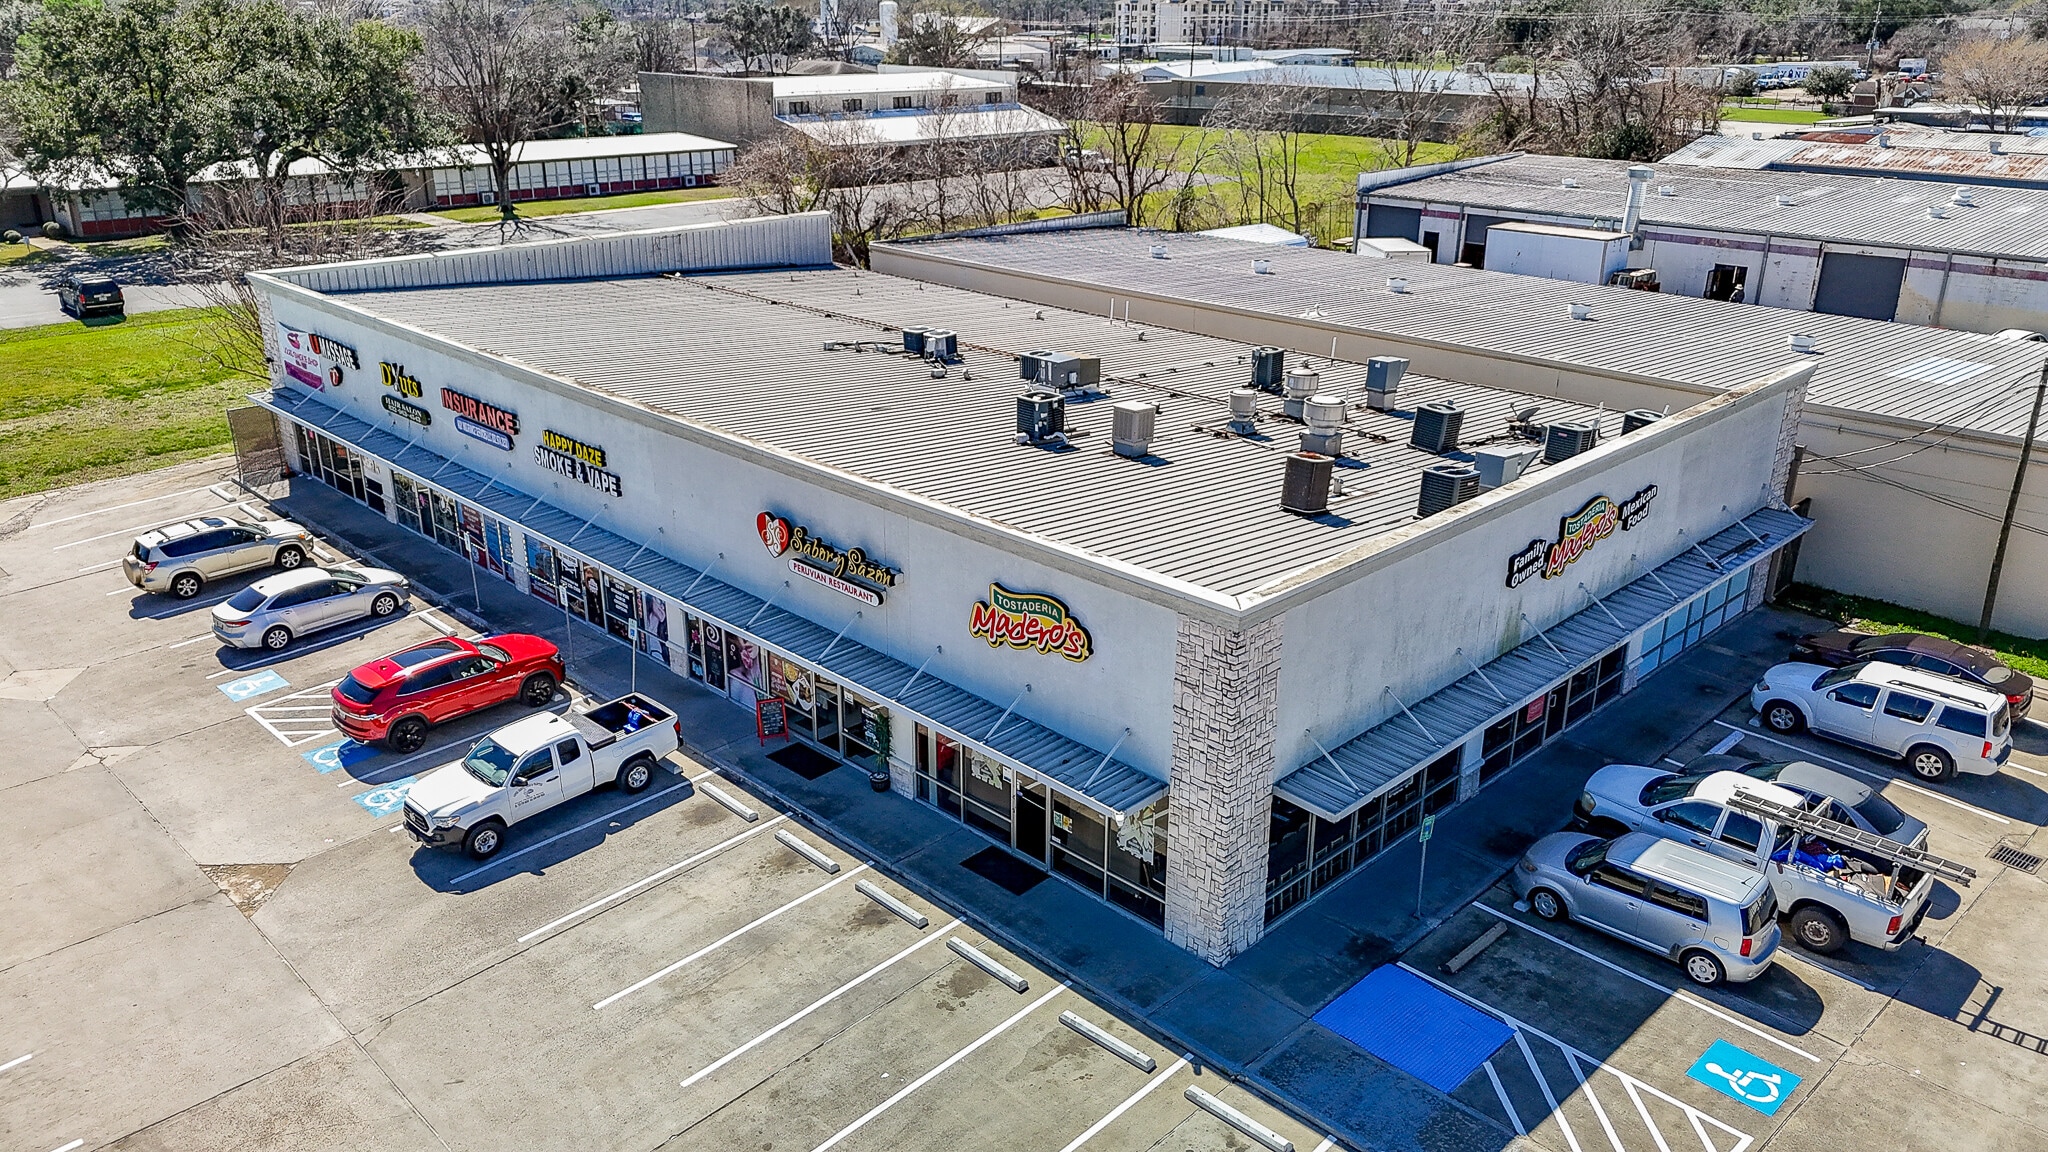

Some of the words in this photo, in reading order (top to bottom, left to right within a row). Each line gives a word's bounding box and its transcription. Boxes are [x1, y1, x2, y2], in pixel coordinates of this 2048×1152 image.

[318, 337, 358, 370] MASSAGE
[385, 396, 401, 409] HAIR
[401, 403, 422, 417] SALON
[440, 387, 516, 435] INSURANCE
[542, 430, 574, 456] HAPPY
[575, 444, 603, 467] DAZE
[533, 446, 573, 479] SMOKE
[575, 463, 585, 484] &
[586, 466, 619, 497] VAPE
[1622, 486, 1657, 520] Mexican
[1627, 503, 1649, 529] Food
[790, 526, 834, 562] Sabor
[833, 554, 845, 578] y
[847, 548, 892, 587] Sazón
[1513, 540, 1546, 573] Family
[1547, 506, 1616, 575] Madero's
[793, 562, 826, 584] PERUVIAN
[828, 577, 874, 603] RESTAURANT
[1511, 554, 1544, 588] Owned
[996, 594, 1059, 619] TOSTADERIA
[972, 605, 1083, 654] Madero's
